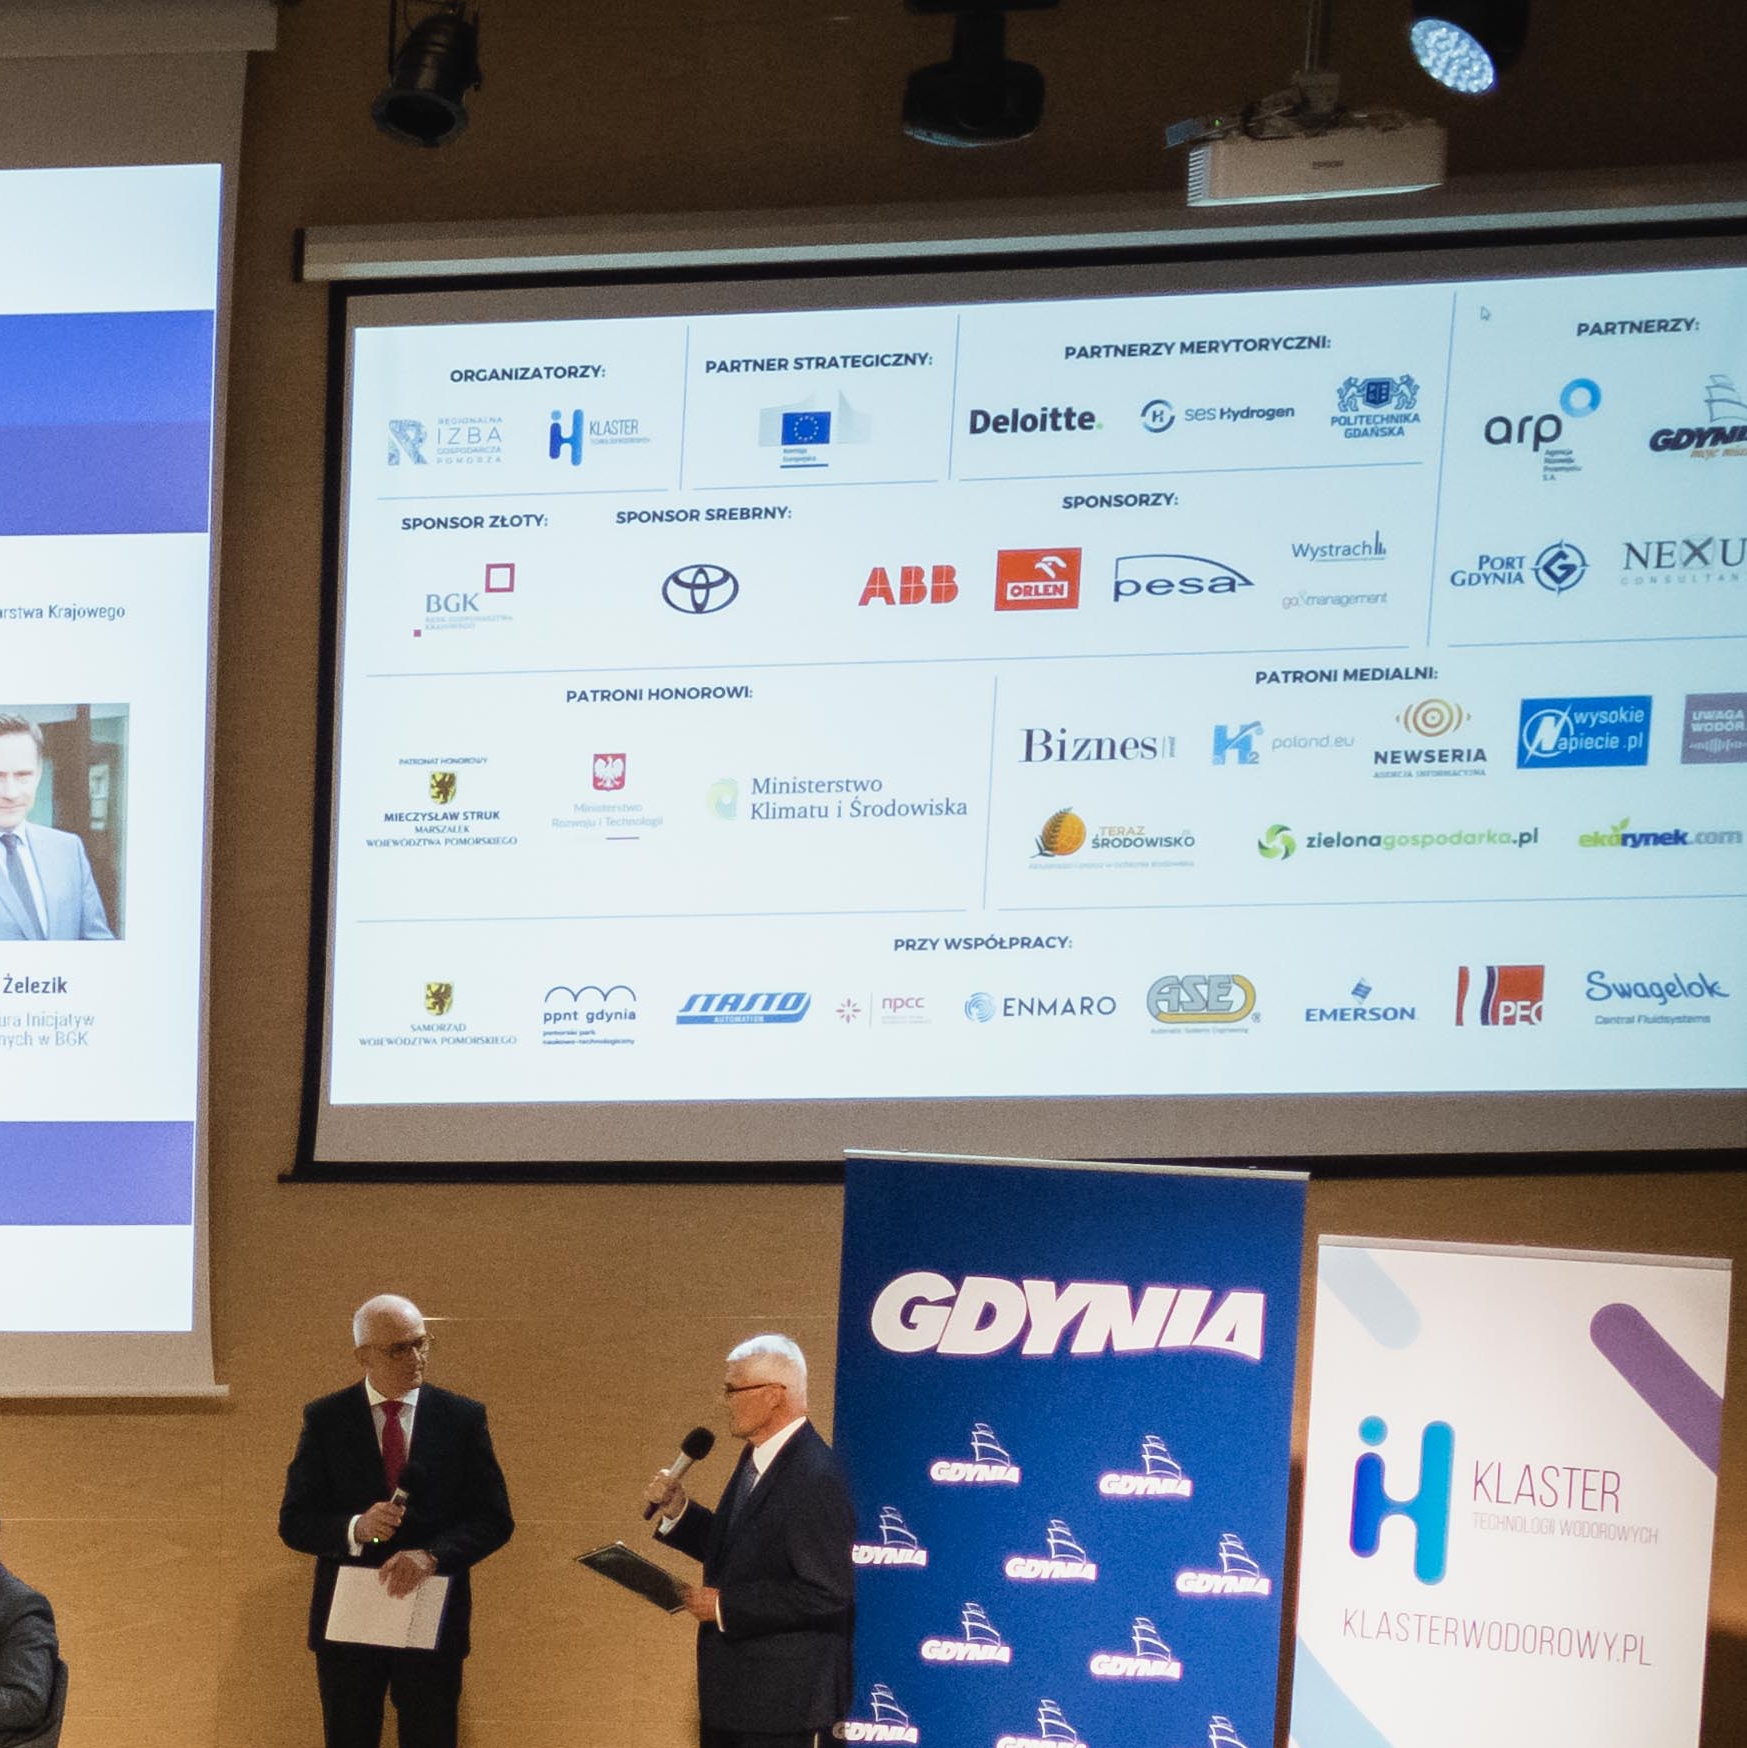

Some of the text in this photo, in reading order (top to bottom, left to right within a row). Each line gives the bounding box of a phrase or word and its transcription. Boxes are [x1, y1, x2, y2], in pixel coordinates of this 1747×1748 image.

[1577, 318, 1700, 336] PARTNERZY:
[1064, 336, 1331, 360] PARTNERZY MERYTORYCZNI:
[705, 352, 932, 373] PARTNER STRATEGICZNY:
[450, 365, 605, 383] ORGANIZATORZY:
[1219, 406, 1295, 421] Hydrogen
[1330, 413, 1420, 426] POLITECHNIKA
[437, 427, 503, 445] IZBA
[589, 419, 639, 436] KLASTER
[1344, 425, 1405, 439] GDAŃSKA
[1484, 410, 1562, 452] arp
[1062, 493, 1179, 510] SPONSORZY:
[401, 513, 548, 530] SPONSOR ZŁOTY:
[616, 506, 792, 524] SPONSOR SREBRNY:
[1292, 540, 1372, 561] Wystrach
[859, 565, 959, 606] ABB
[1010, 583, 1064, 598] ORLEN
[48, 602, 125, 622] Krajowego
[426, 593, 479, 613] BGK
[1255, 667, 1438, 685] PATRONI MEDIALNI:
[566, 685, 753, 703] PATRONI HONOROWI:
[1574, 706, 1644, 728] wysokie
[1019, 728, 1157, 762] Biznes
[1374, 748, 1487, 765] NEWSERIA
[751, 775, 882, 795] Ministerstwo
[384, 811, 500, 822] MIECZYSŁAW STRUK
[751, 794, 968, 820] Klimatu Środowiska
[1091, 834, 1195, 848] ŚRODOWISKO
[1306, 828, 1539, 850] zielonagospodarka.pl
[1579, 829, 1742, 848] ekorynek.com
[893, 934, 1072, 951] PRZY WSPÓŁPRACY:
[3, 973, 67, 995] Żelezik
[1585, 970, 1729, 1005] Swagelok
[585, 1007, 636, 1025] gdynia
[1003, 995, 1117, 1018] ENMARO
[1305, 1006, 1416, 1021] EMERSON
[871, 1271, 1265, 1360] GDYNIA
[930, 1462, 1020, 1484] GDYNIA
[1099, 1474, 1191, 1497] GDYNIA
[1473, 1460, 1621, 1513] KLASTER
[1473, 1512, 1659, 1544] TECHNOLOGII WODOROWYCH
[1005, 1558, 1097, 1581] GDYNIA
[1176, 1572, 1270, 1595] GDYNIA
[1343, 1608, 1652, 1666] KLASTERWODOROWY.PL
[921, 1640, 1011, 1663] GDYNIA
[1090, 1655, 1181, 1679] GDYNIA
